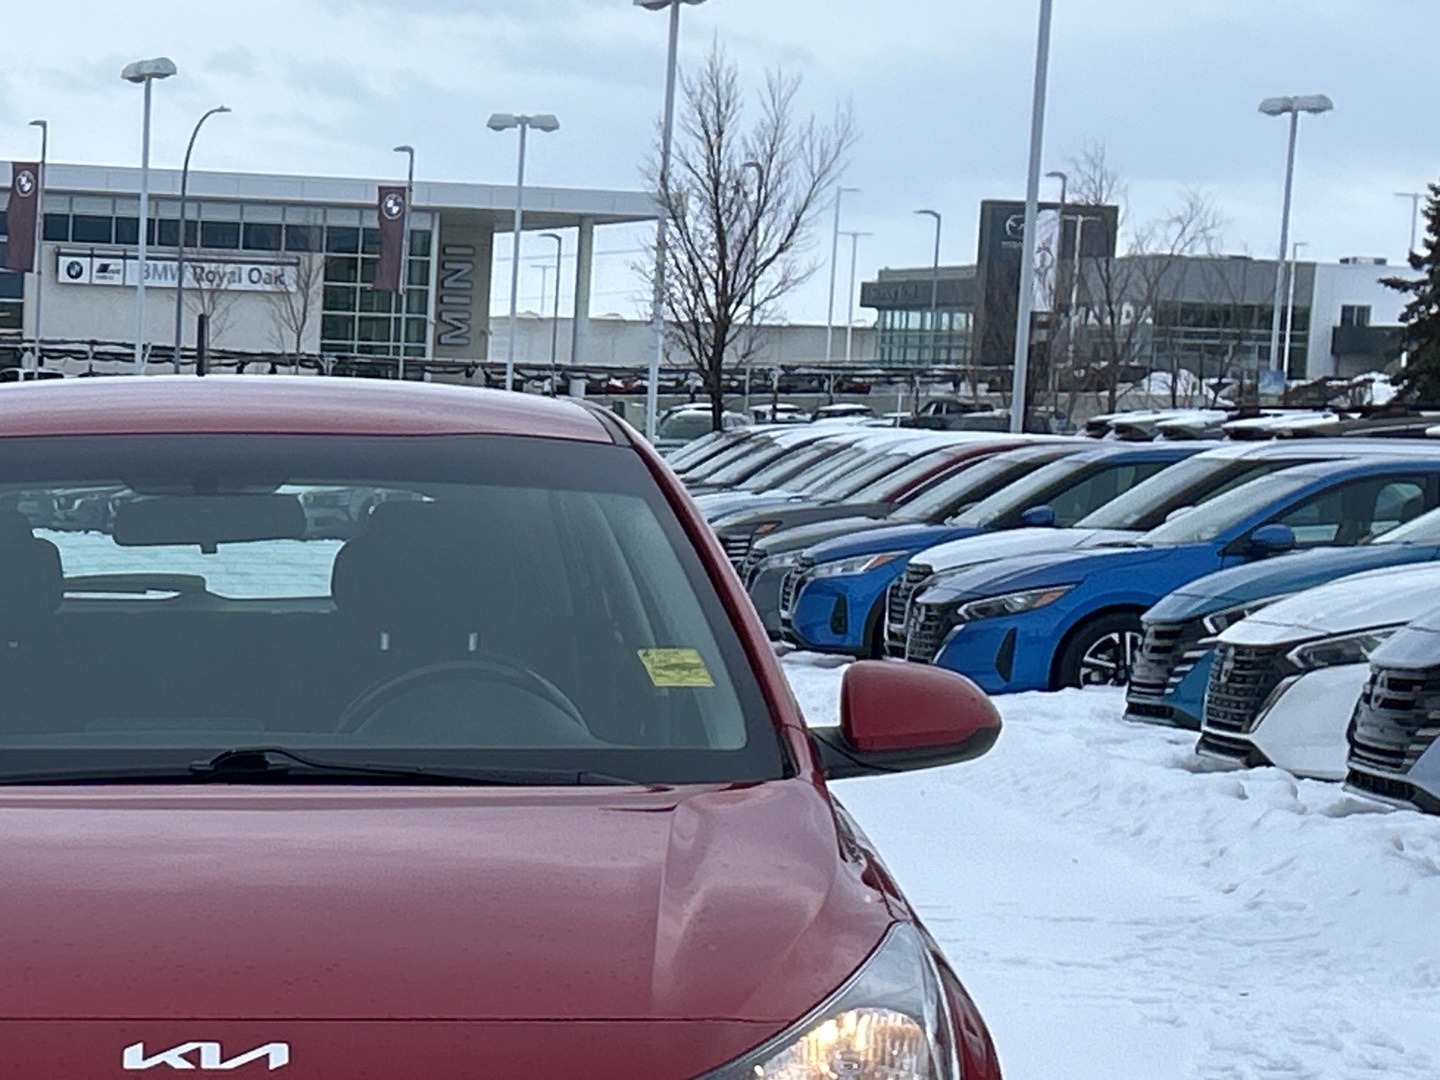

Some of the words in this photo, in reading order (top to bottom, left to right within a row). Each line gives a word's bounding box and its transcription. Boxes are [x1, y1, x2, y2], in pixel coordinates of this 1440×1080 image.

[191, 264, 242, 288] Royal
[248, 267, 285, 286] Oak
[439, 245, 474, 346] MINI
[123, 1042, 289, 1071] KIA
